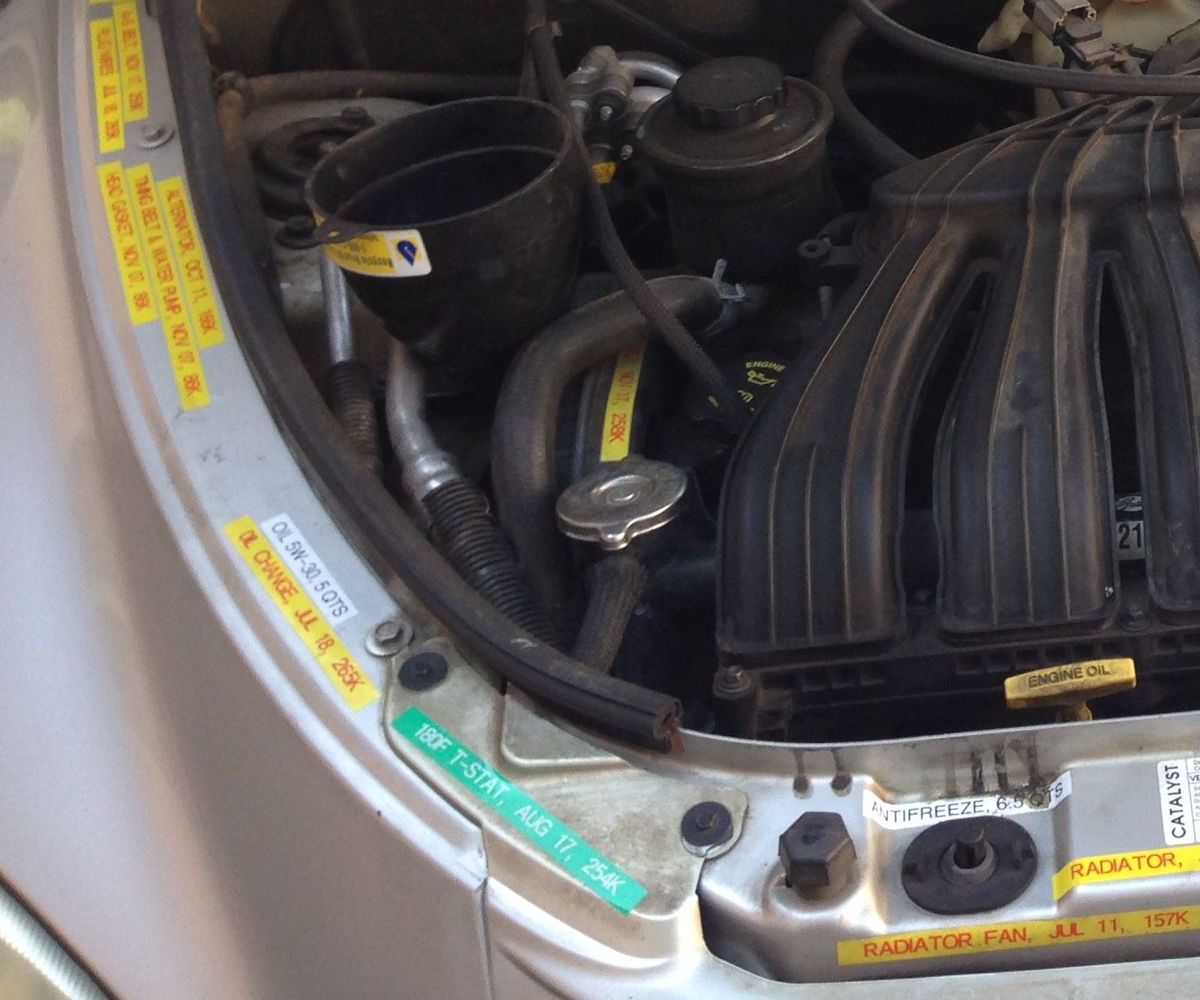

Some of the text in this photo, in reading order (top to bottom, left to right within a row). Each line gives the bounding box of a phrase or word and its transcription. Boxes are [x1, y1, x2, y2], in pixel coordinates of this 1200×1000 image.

[272, 521, 288, 544] OIL
[1119, 523, 1142, 549] 21
[253, 549, 299, 605] CHANGE,
[295, 609, 319, 632] JUL
[316, 633, 335, 657] 18,
[1028, 665, 1111, 688] ENGINE OIL
[414, 722, 626, 896] 180F T-STAT, AUG 17, 254K
[1164, 763, 1187, 839] CATALYST
[1070, 853, 1183, 880] RADIATOR,
[863, 910, 1189, 958] RADIATOR FAN, JUL 11, 157K
